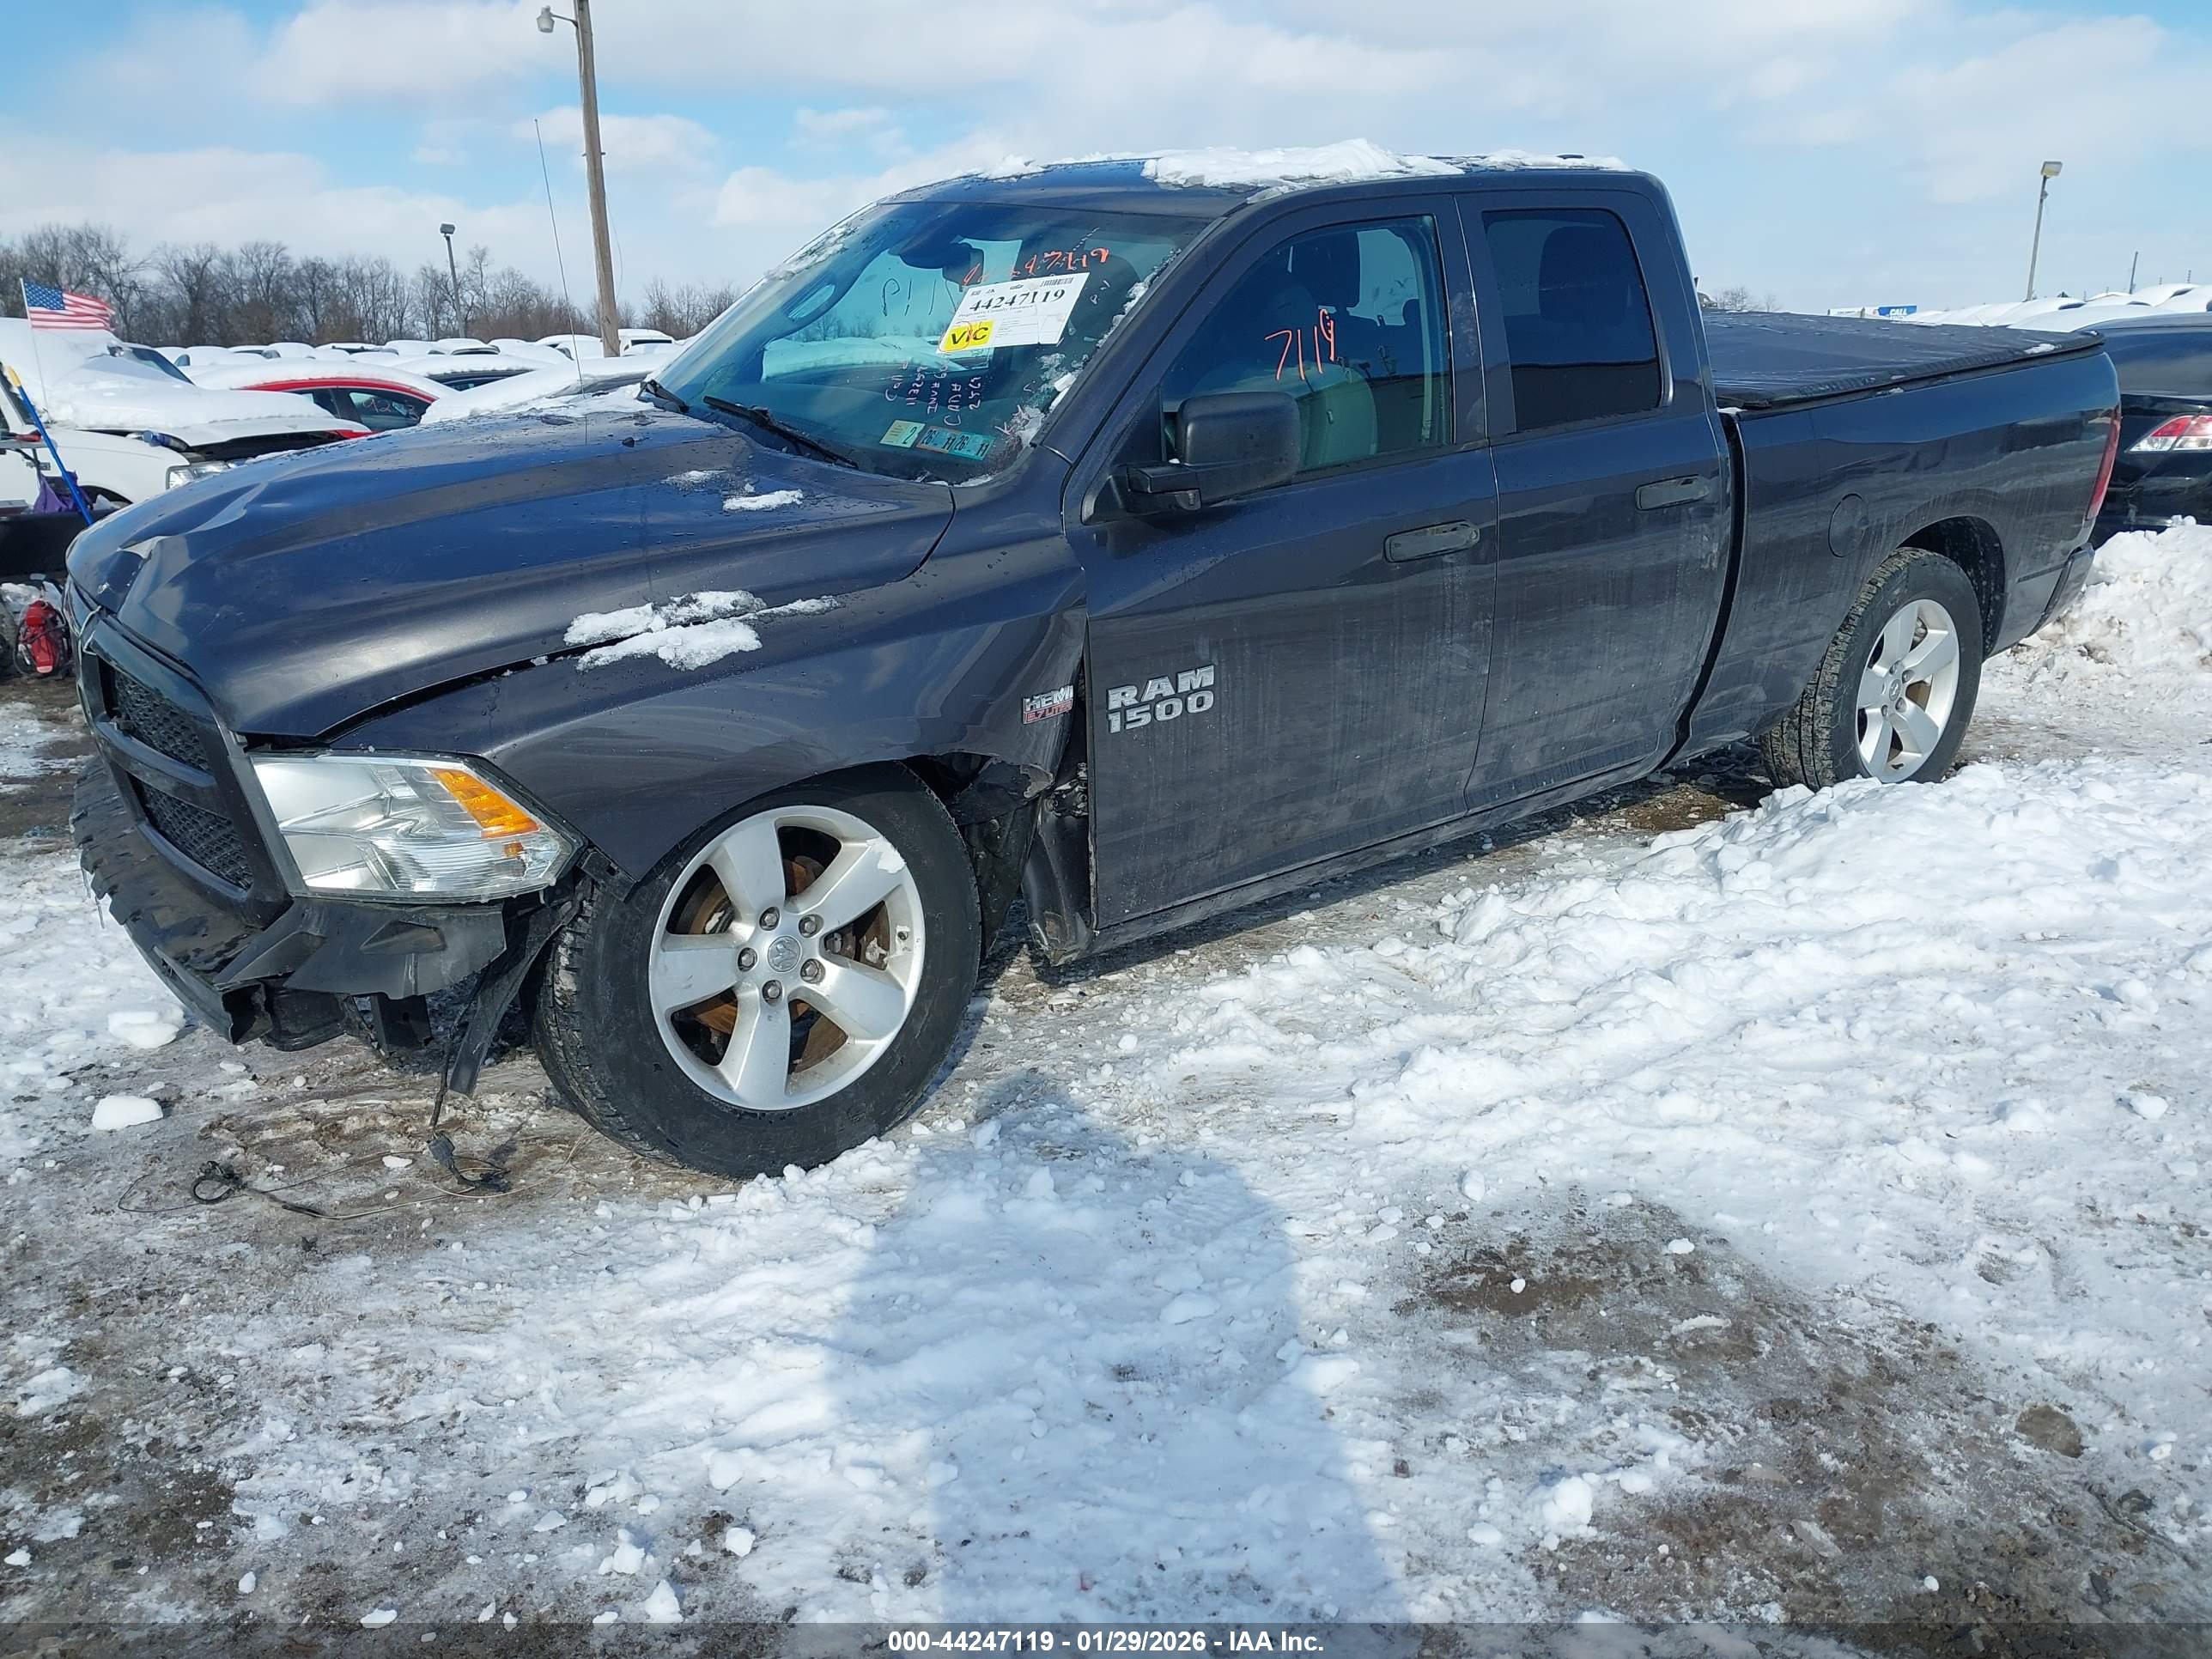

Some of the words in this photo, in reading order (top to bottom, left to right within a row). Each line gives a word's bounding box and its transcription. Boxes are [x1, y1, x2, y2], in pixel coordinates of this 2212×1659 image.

[969, 289, 1066, 312] 44247119
[951, 326, 989, 345] VIC
[1024, 685, 1073, 712] HEMI
[1108, 665, 1215, 710] RAM
[1108, 690, 1214, 734] 1500
